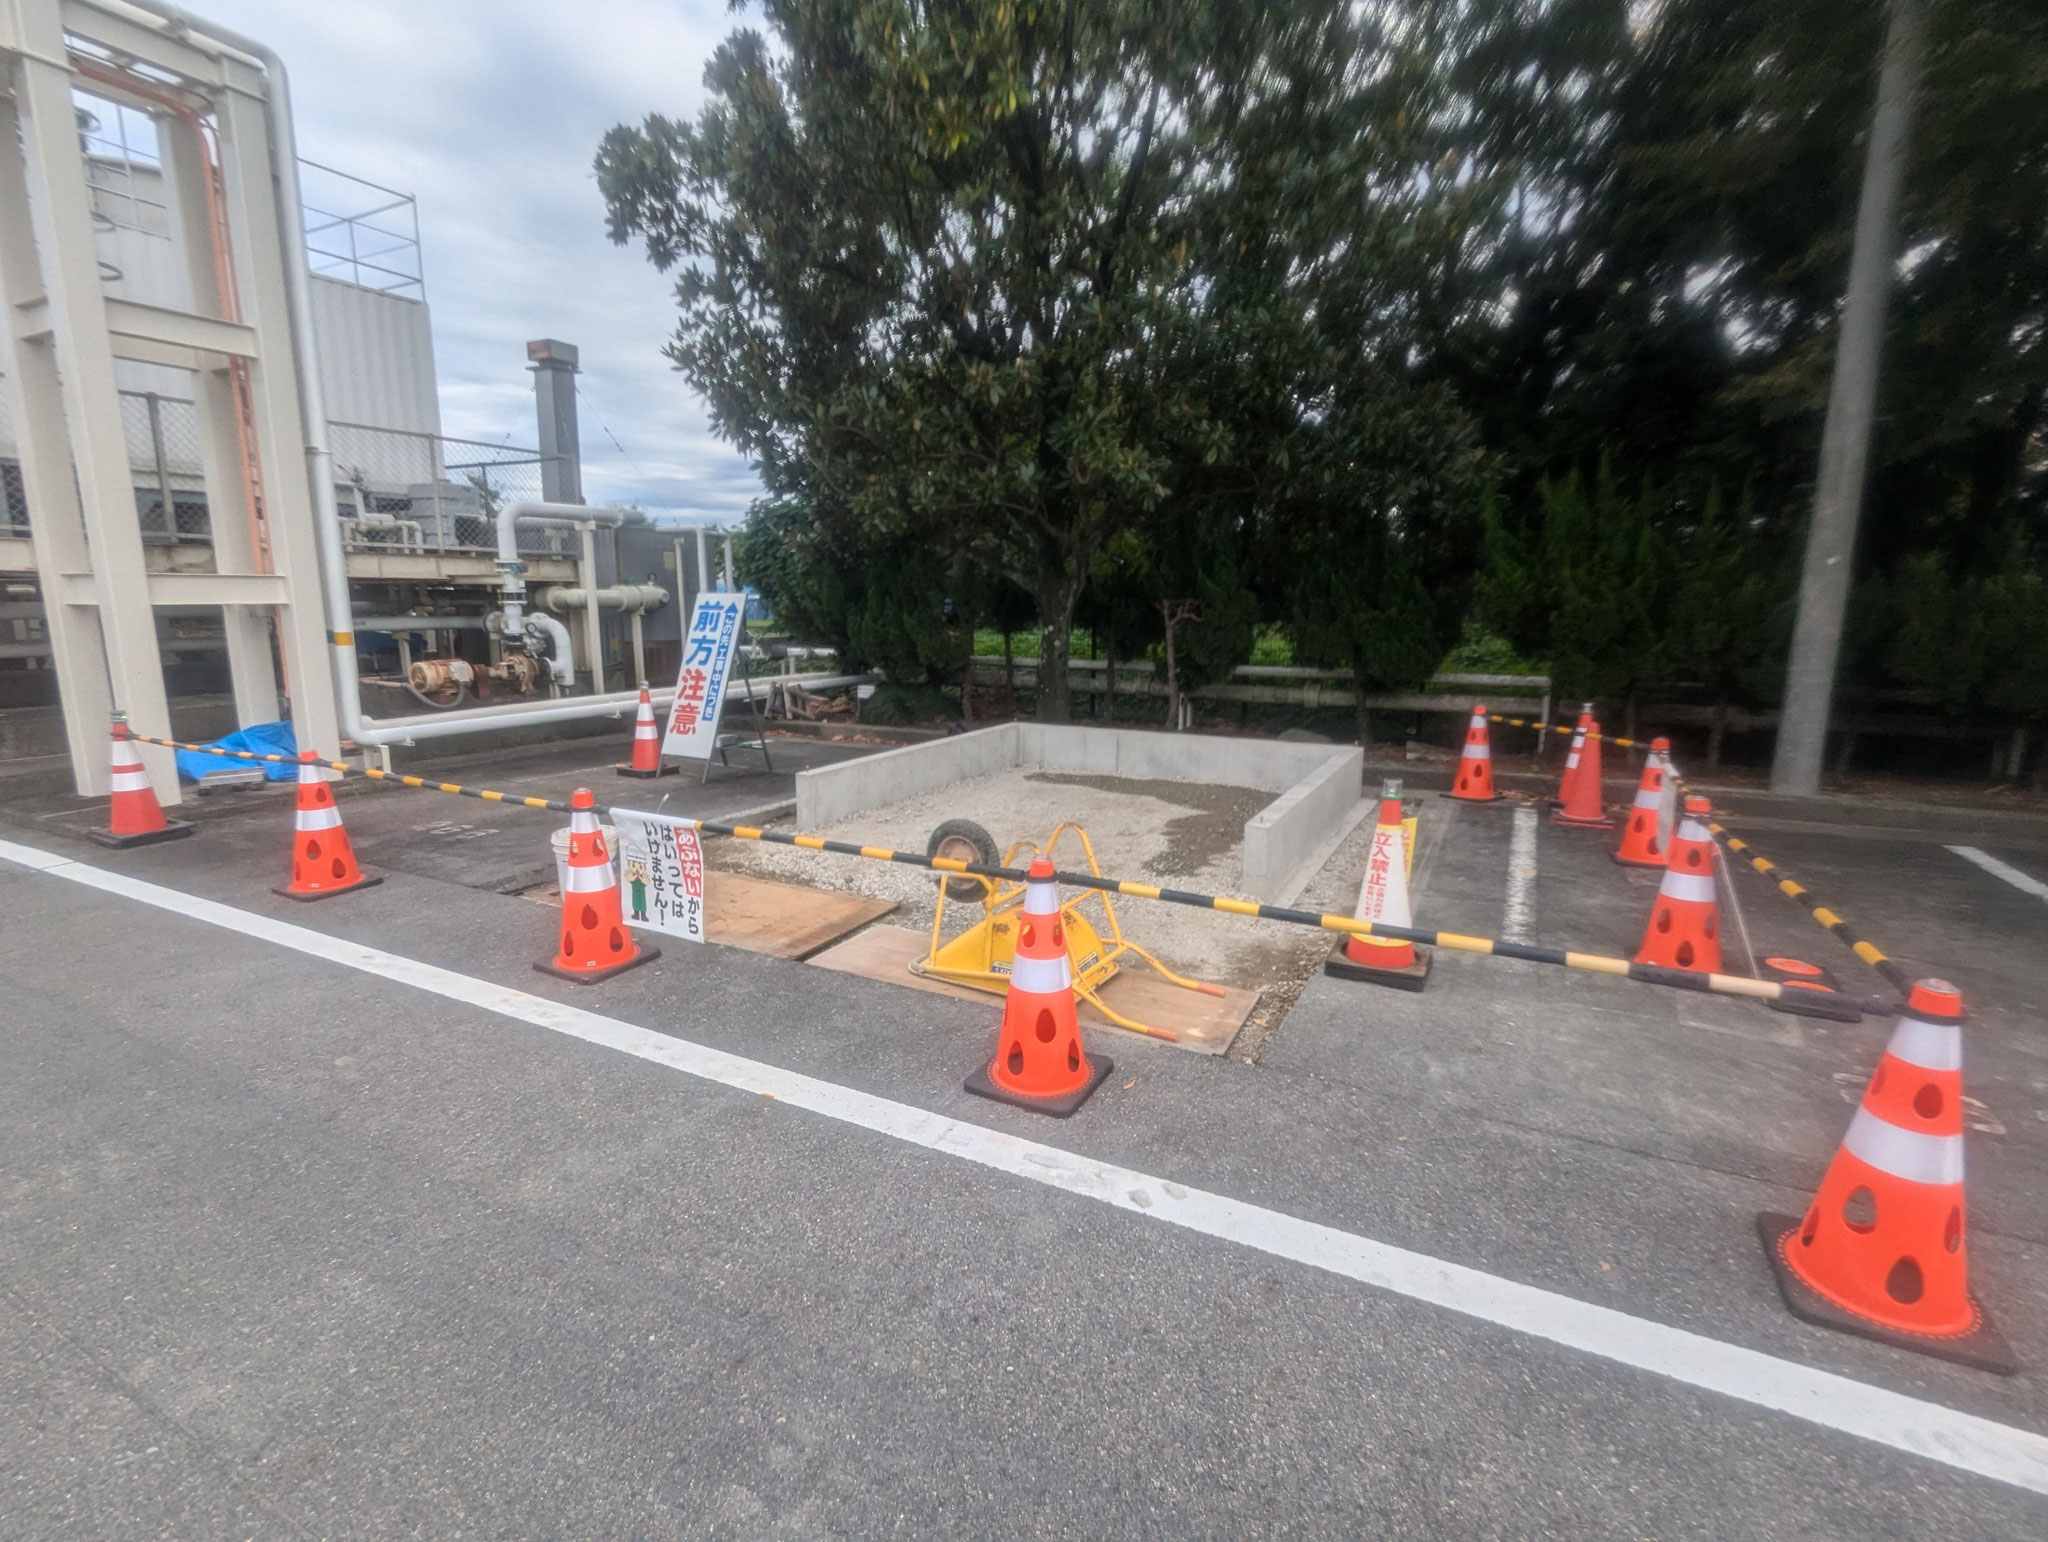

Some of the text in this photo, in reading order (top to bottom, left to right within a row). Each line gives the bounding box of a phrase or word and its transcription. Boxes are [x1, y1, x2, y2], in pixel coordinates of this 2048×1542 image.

[669, 601, 725, 735] 前方注意
[704, 611, 734, 719] この先工事中につき
[676, 828, 701, 935] あぶないから
[1368, 831, 1393, 887] 立入禁止
